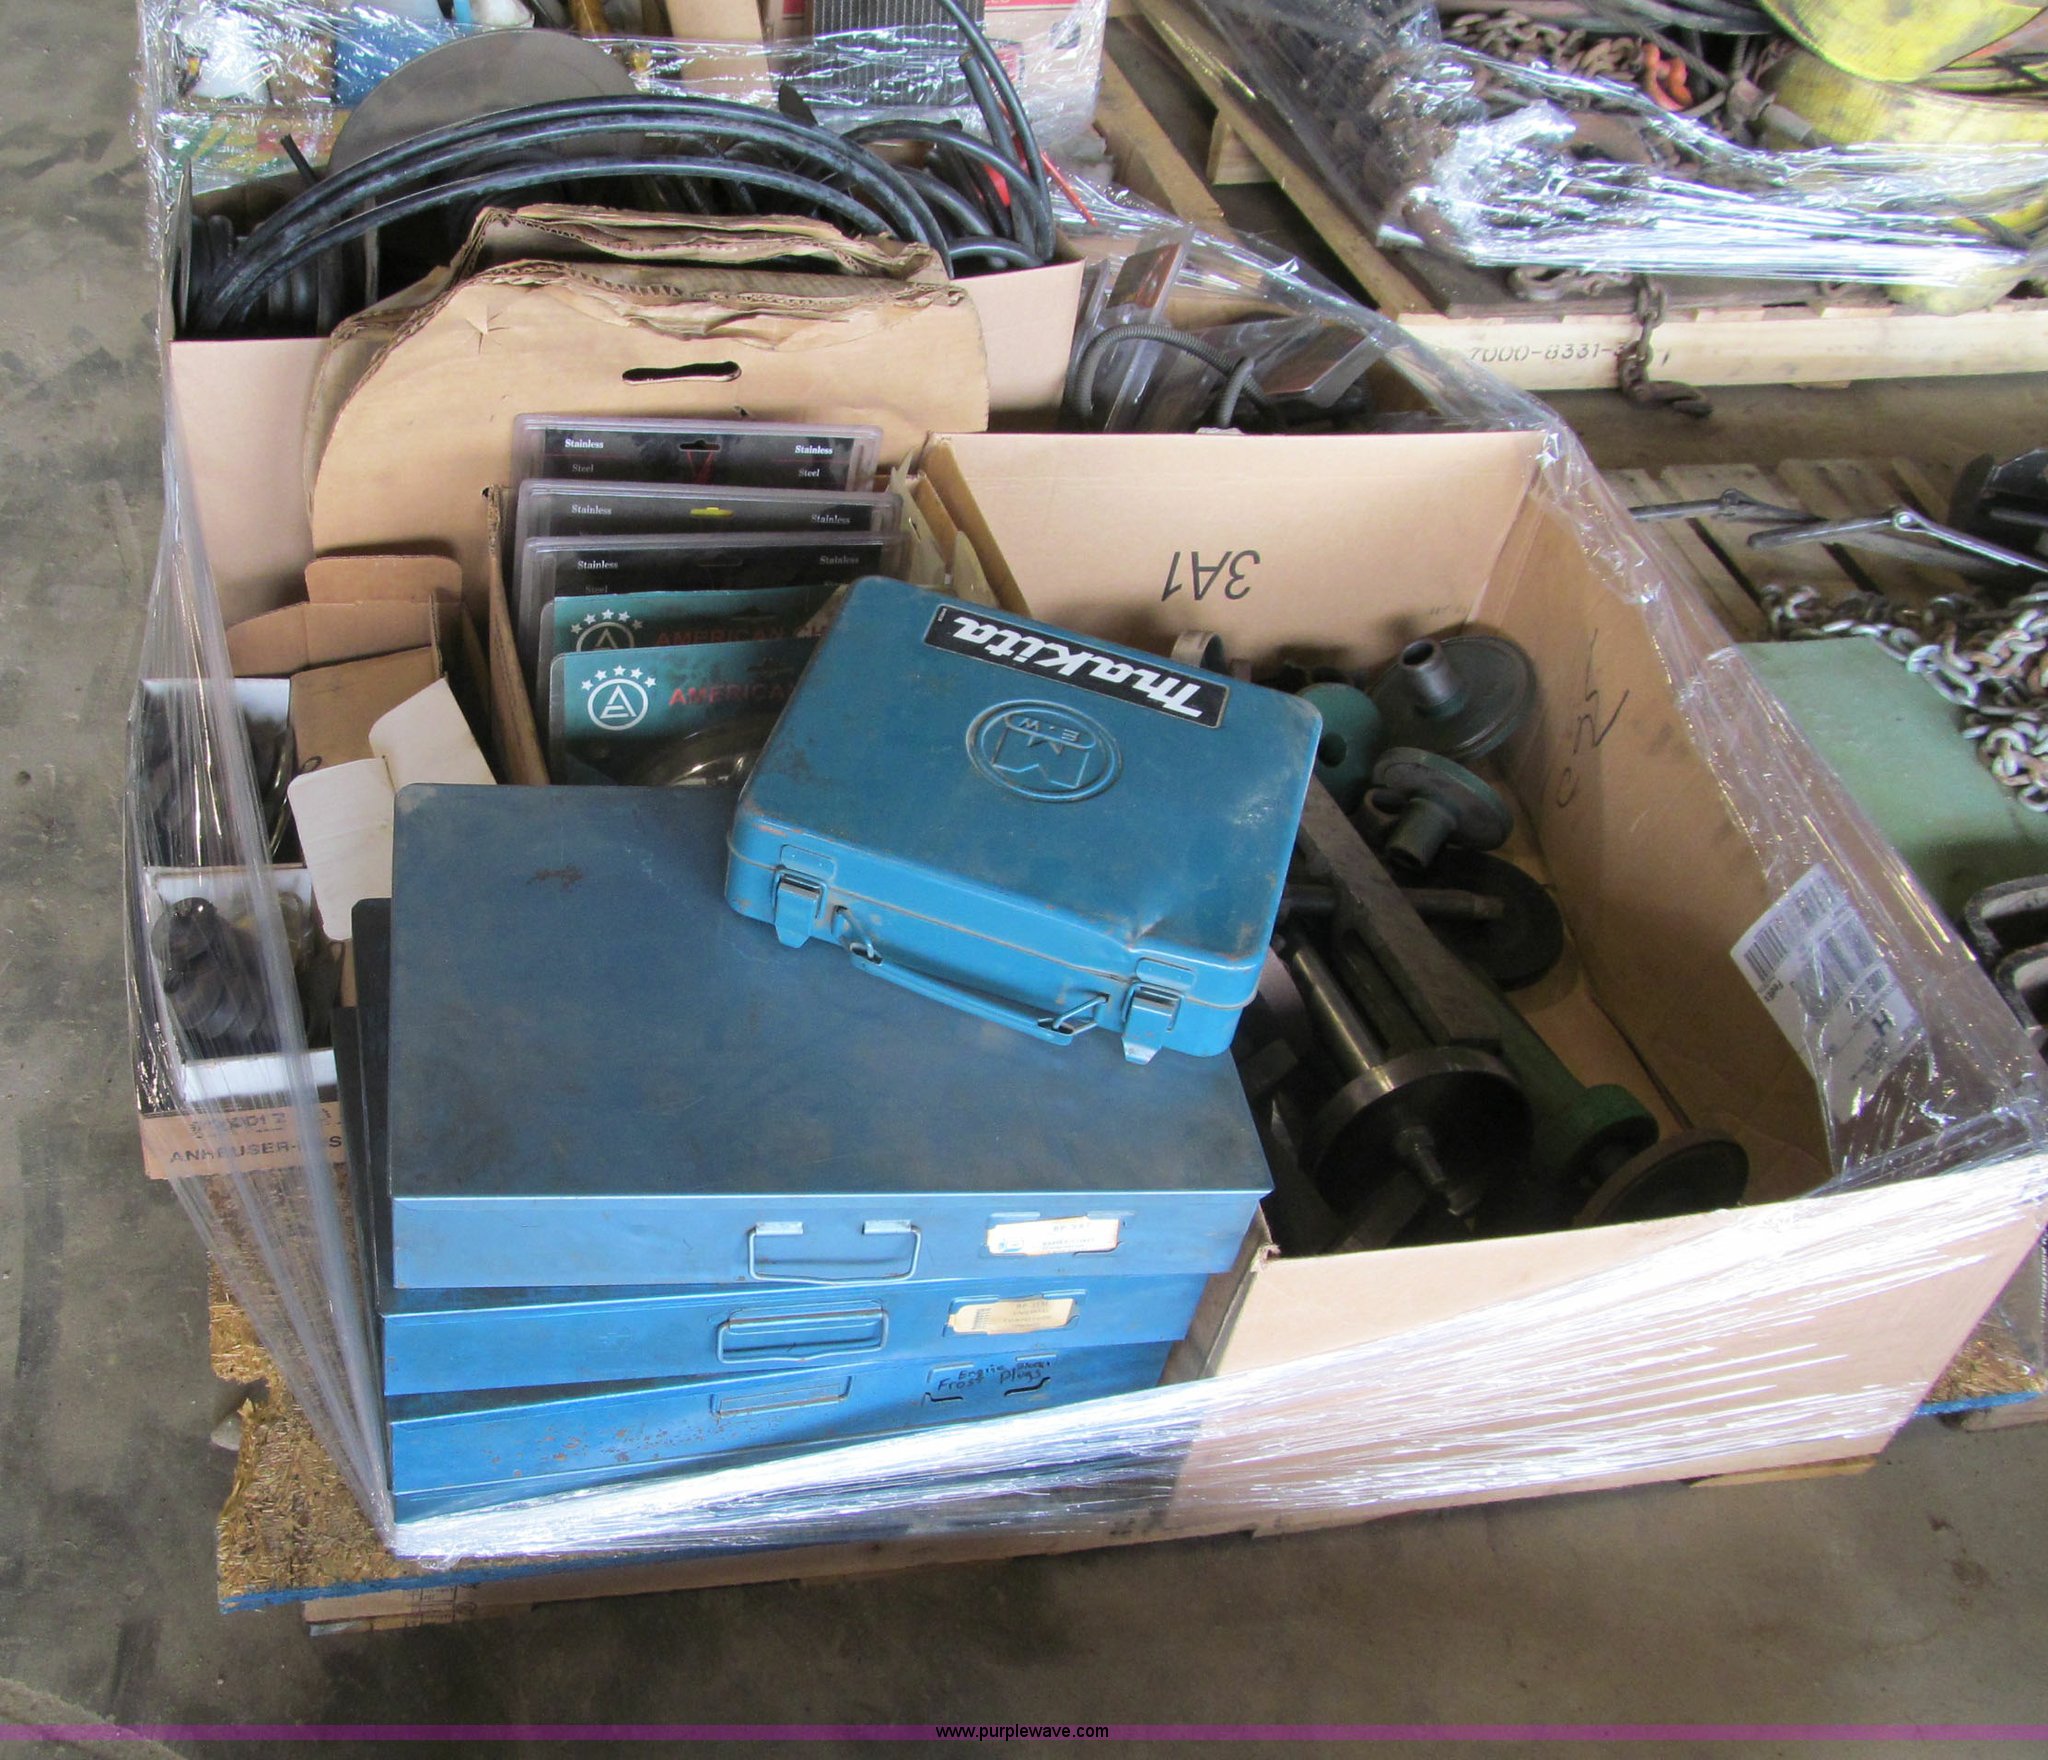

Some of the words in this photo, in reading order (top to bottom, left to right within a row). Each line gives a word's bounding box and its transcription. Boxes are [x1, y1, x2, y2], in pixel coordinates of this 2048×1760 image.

[564, 438, 604, 450] Stainless
[794, 444, 833, 456] Stainless
[572, 462, 594, 473] Steel
[798, 467, 820, 478] Steel
[571, 504, 612, 516] Stainless
[811, 513, 850, 525] Stainless
[577, 559, 618, 571] Stainless
[819, 555, 859, 566] Stainless
[1161, 549, 1261, 602] 3A1
[668, 682, 795, 706] AMERICA
